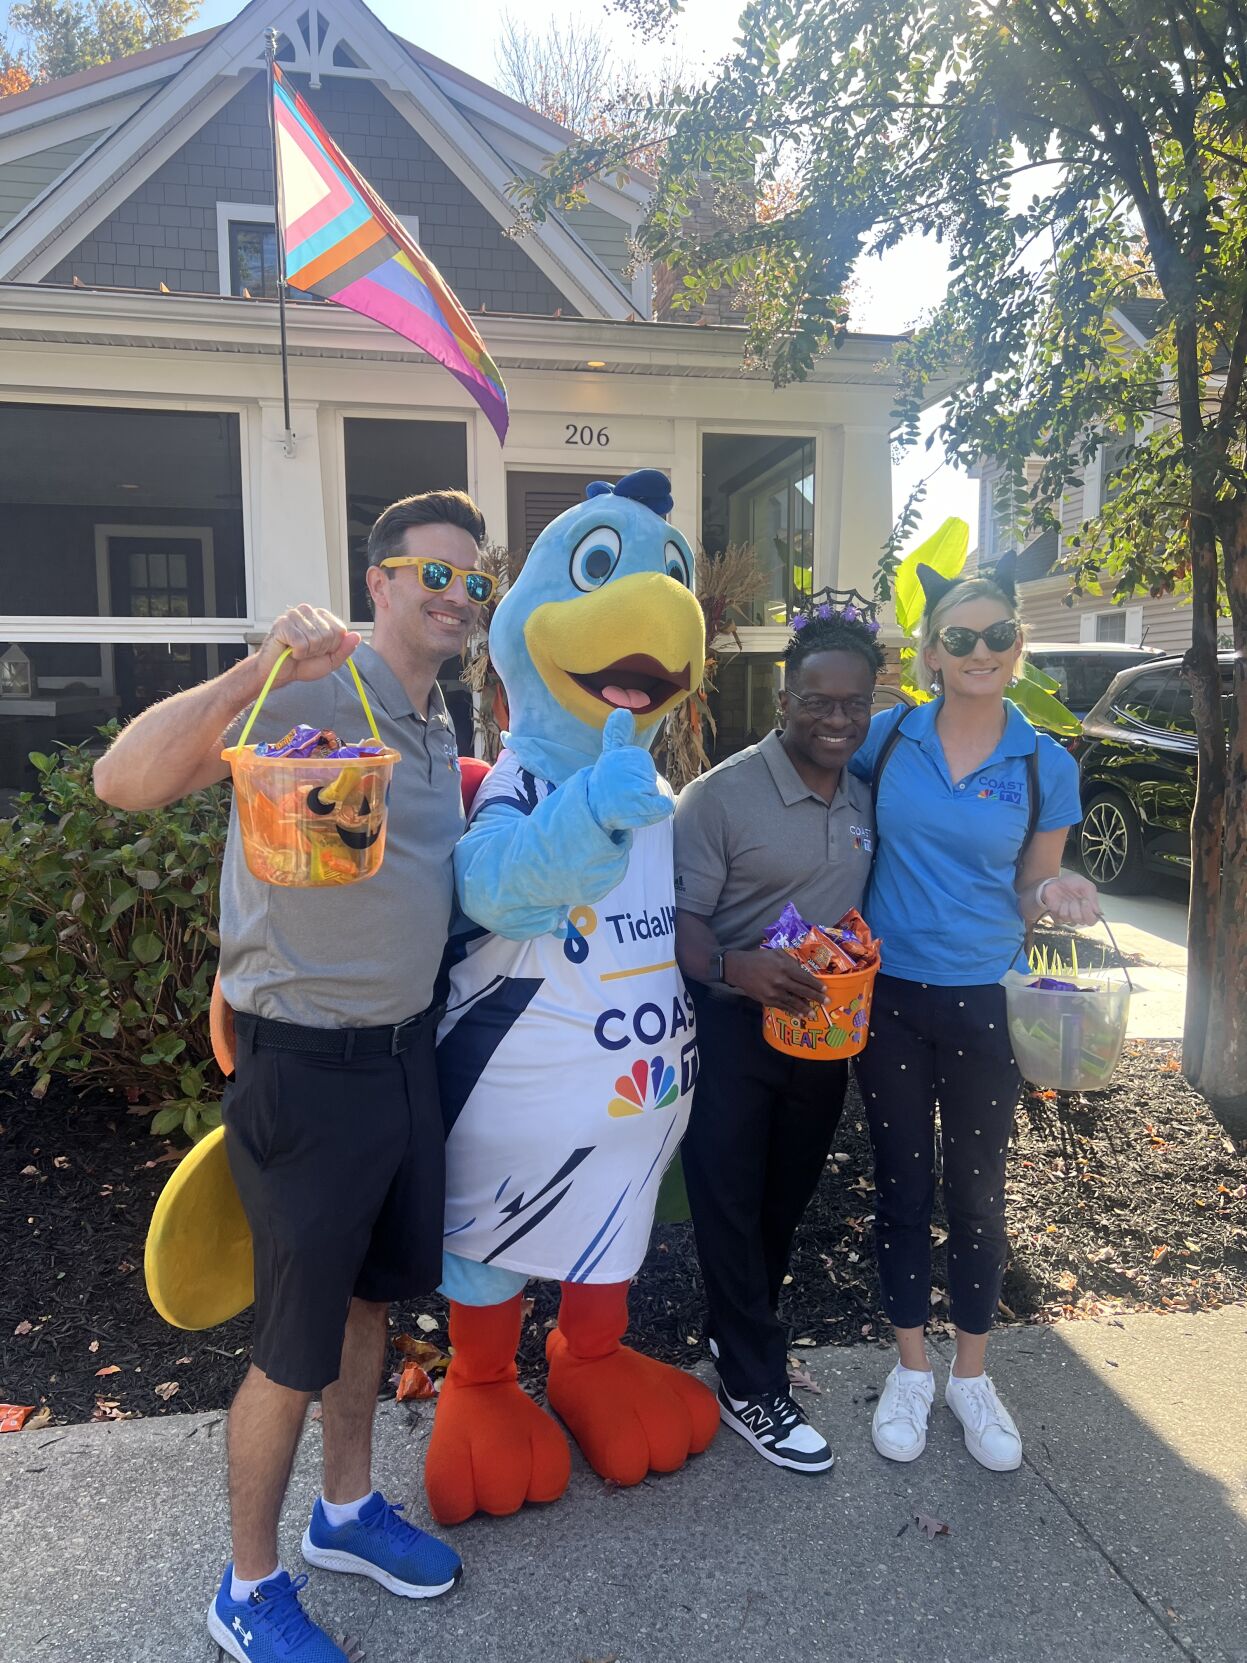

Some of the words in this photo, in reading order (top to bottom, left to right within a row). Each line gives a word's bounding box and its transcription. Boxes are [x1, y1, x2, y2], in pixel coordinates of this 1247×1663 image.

[565, 424, 609, 446] 206
[979, 776, 1024, 792] COAST
[1001, 792, 1020, 803] TV
[791, 1018, 806, 1029] OR
[777, 1018, 823, 1049] TREAT
